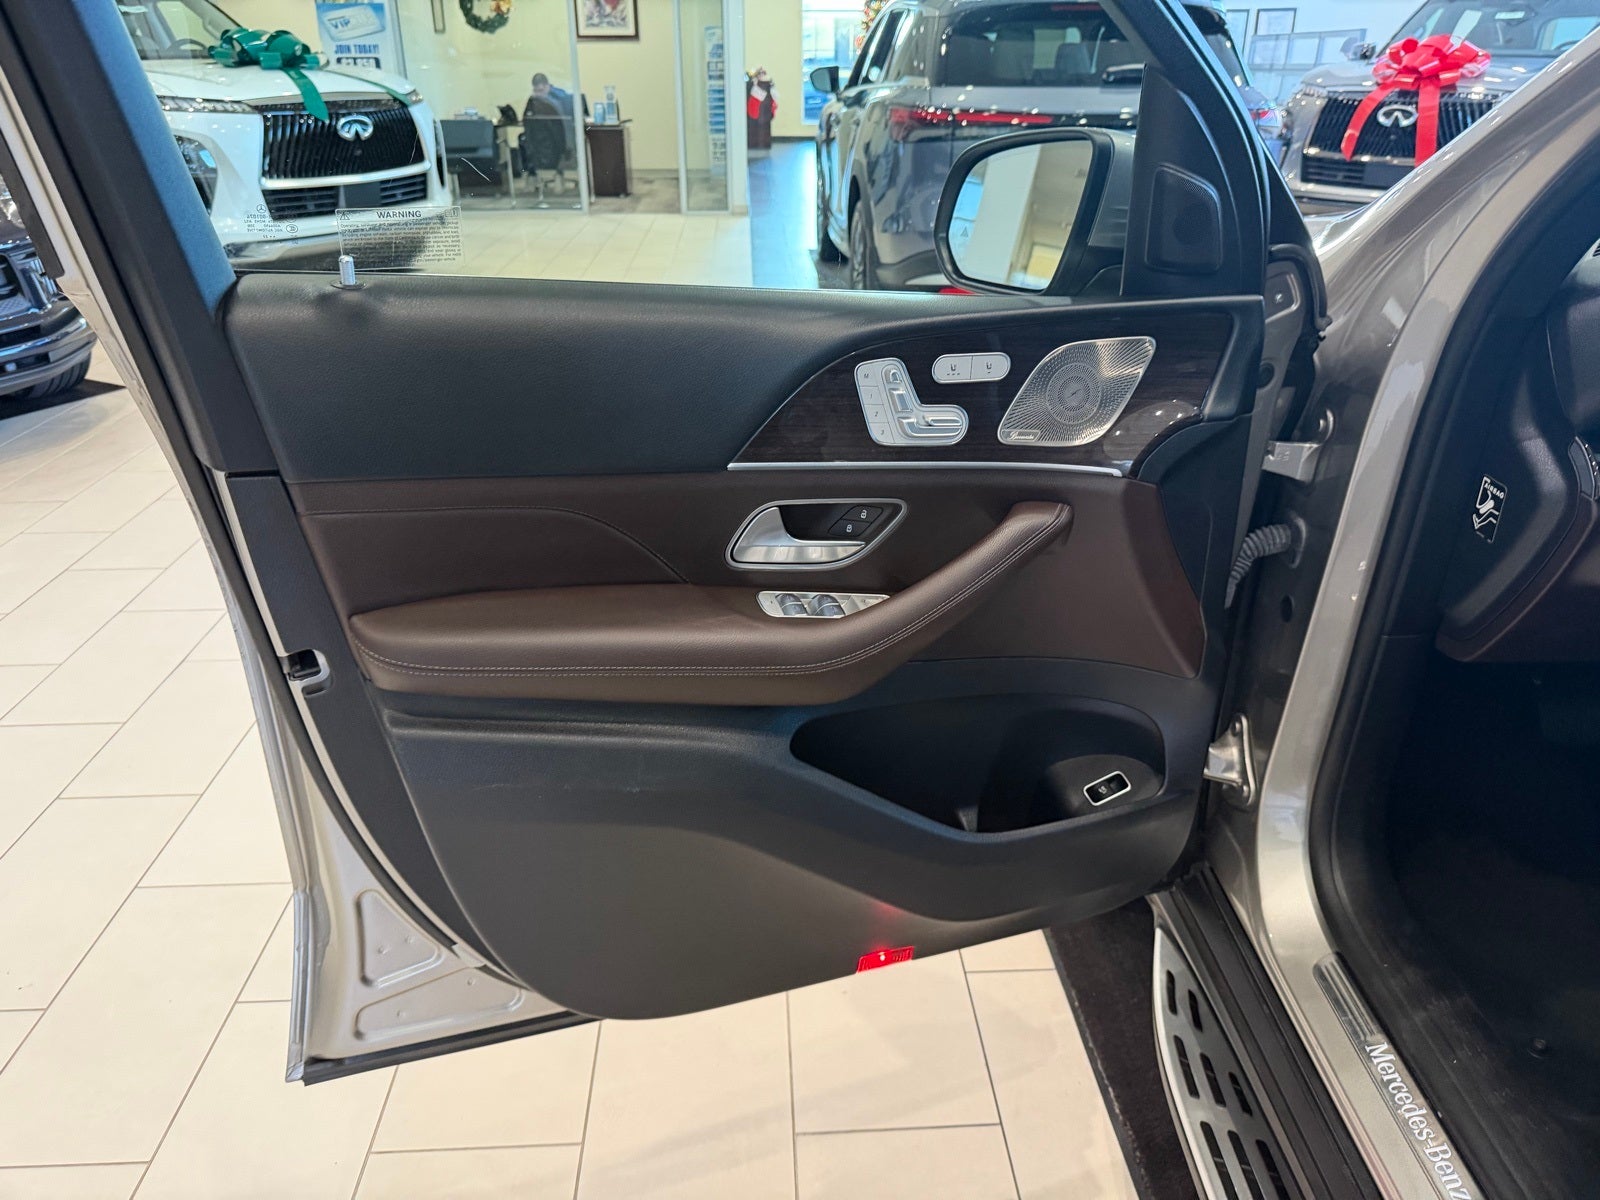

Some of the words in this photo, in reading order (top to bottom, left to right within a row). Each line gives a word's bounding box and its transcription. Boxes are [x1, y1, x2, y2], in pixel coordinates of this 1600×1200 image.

[330, 18, 350, 29] VIP
[335, 44, 352, 54] JOIN
[376, 210, 422, 219] WARNING
[1484, 482, 1505, 499] AIRBAG
[1365, 1041, 1471, 1200] Mercedes-Benz
